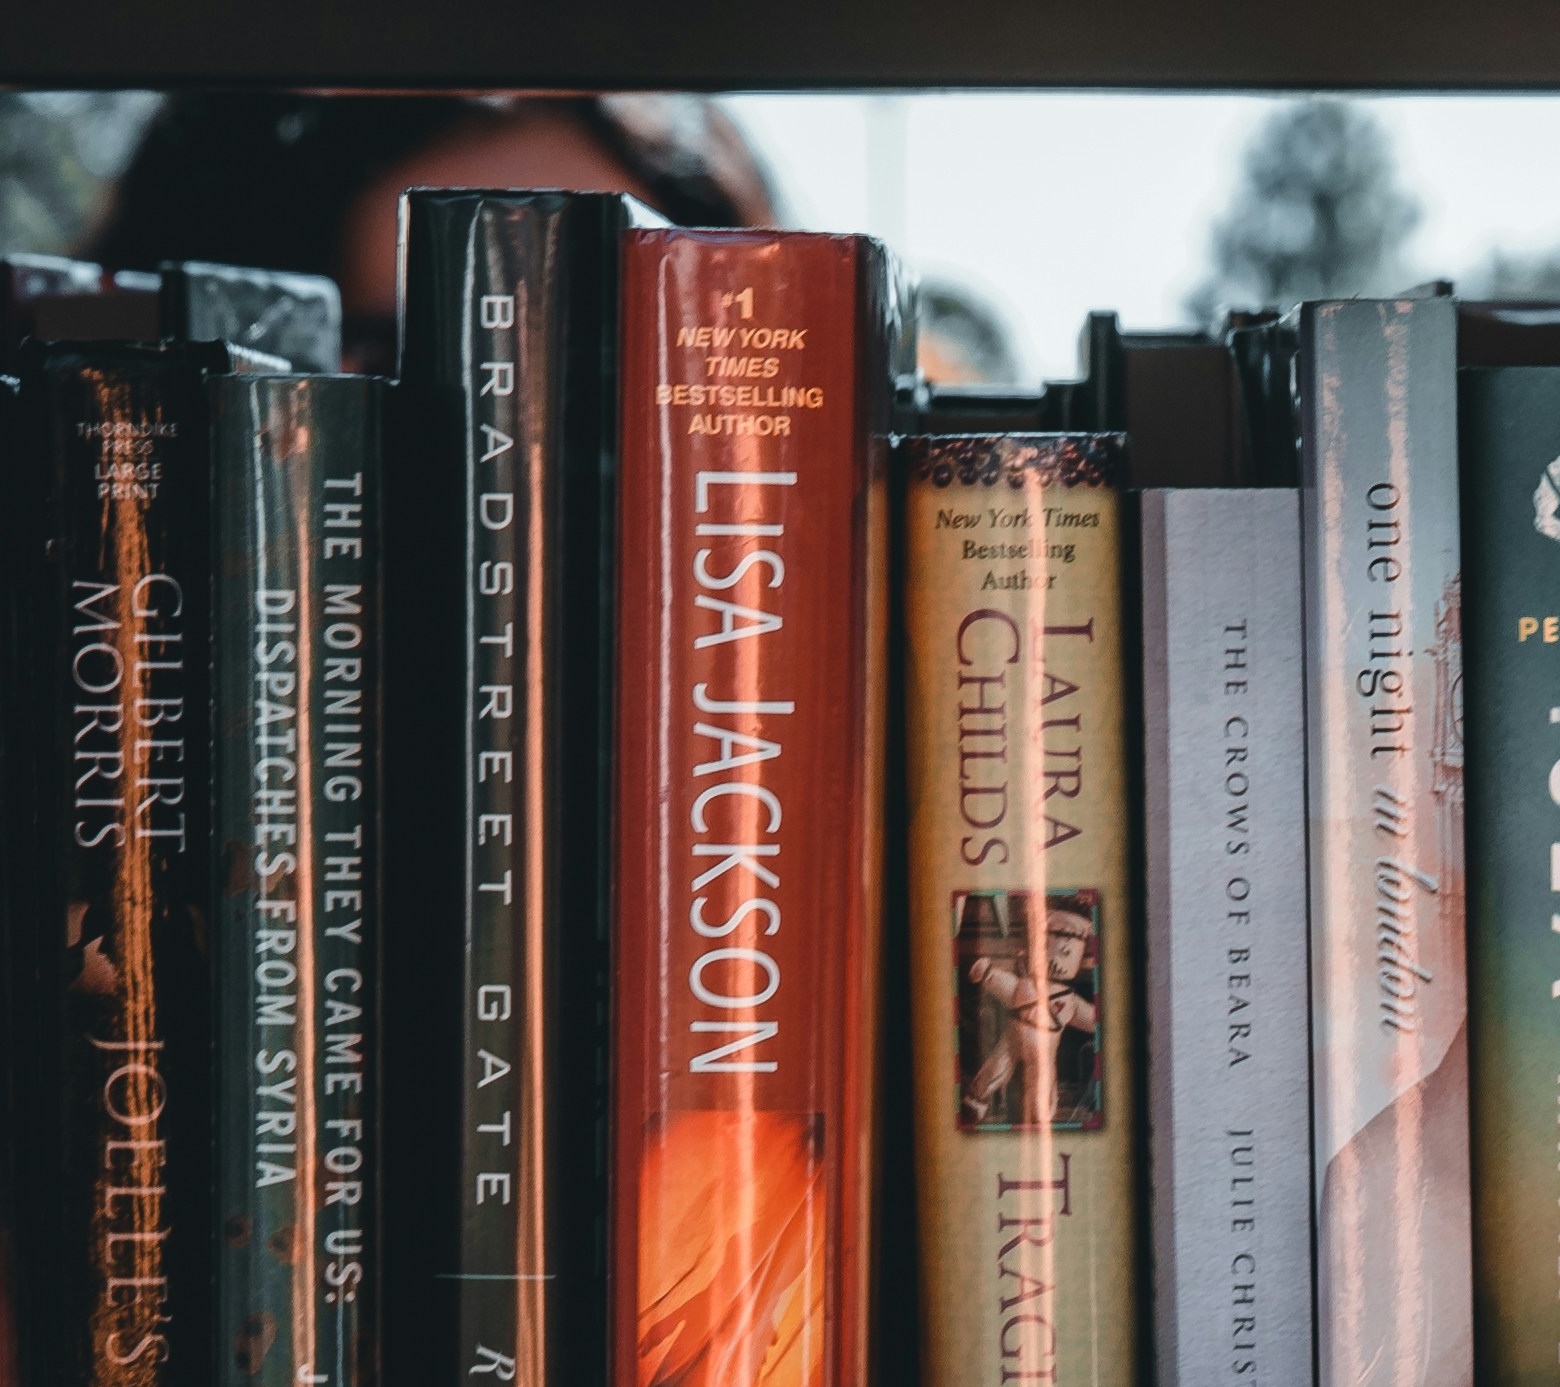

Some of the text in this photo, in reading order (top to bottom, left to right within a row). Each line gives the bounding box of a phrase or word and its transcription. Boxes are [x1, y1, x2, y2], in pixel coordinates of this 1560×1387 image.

[677, 327, 806, 349] NEW YORK
[704, 357, 779, 378] TIMES
[722, 288, 754, 320] #1
[655, 386, 823, 408] BESTSELLING
[687, 414, 791, 436] AUTHOR
[689, 470, 798, 1073] LISA JACKSON
[957, 609, 1018, 866] CHILDS
[1029, 615, 1093, 851] LAURA
[324, 472, 363, 1307] THE MORNING THEY CAME FOR US:
[1221, 619, 1252, 1066] THE CROWS OF BEARA
